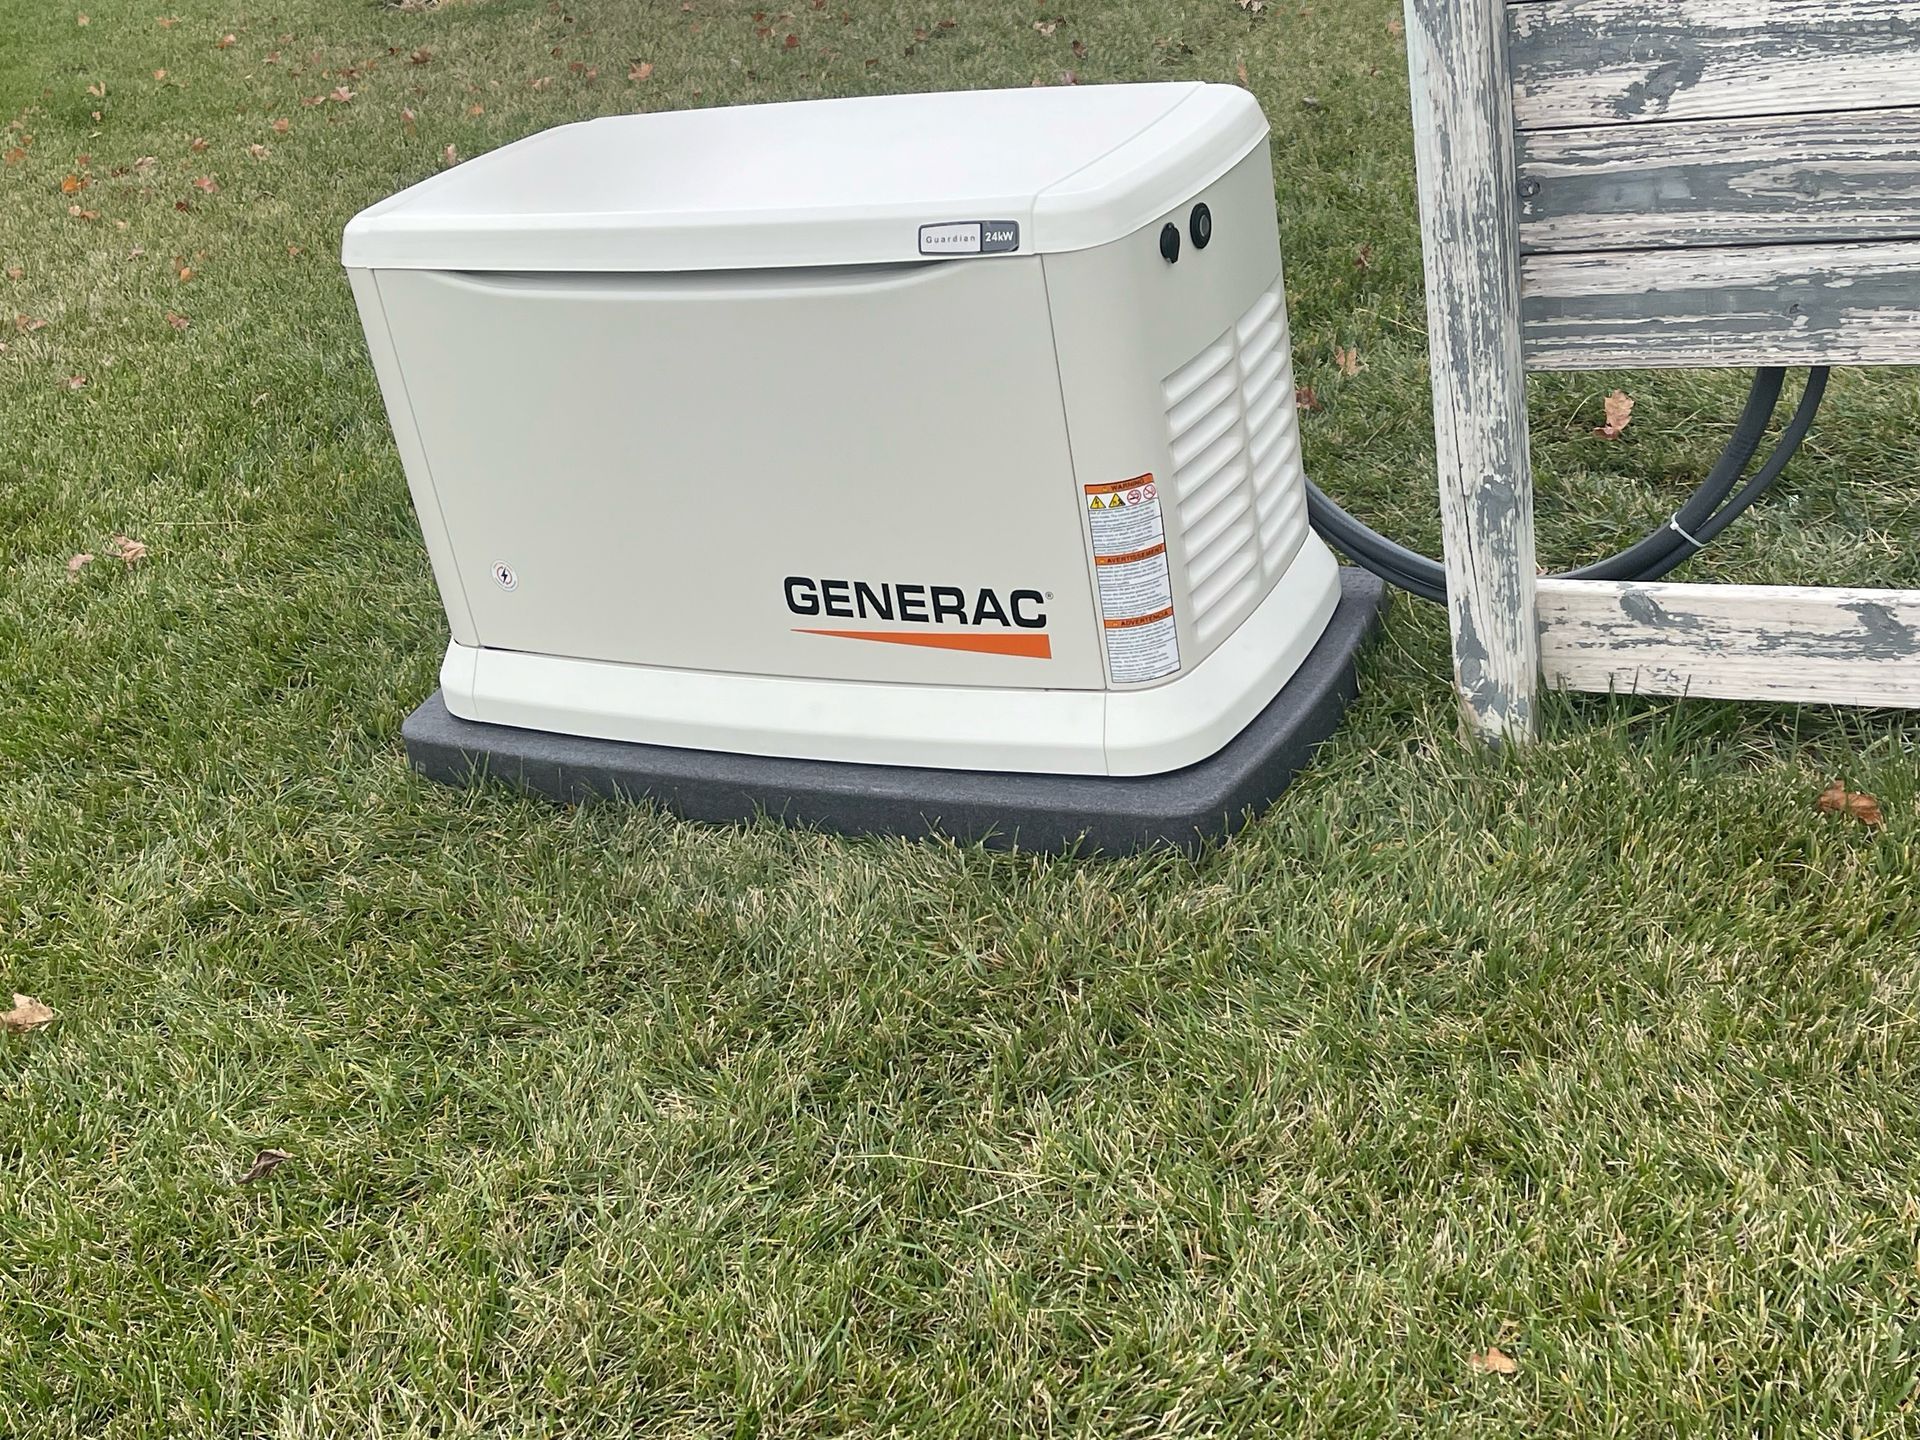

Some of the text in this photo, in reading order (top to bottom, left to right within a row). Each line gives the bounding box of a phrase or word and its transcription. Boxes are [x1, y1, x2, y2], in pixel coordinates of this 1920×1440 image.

[925, 231, 1014, 244] Guardian 24kW
[1110, 479, 1145, 491] WARNING
[1107, 546, 1163, 563] AVERTISSEMENT
[784, 576, 1048, 629] GENERAC
[1120, 610, 1169, 626] ADVERTENCIA
